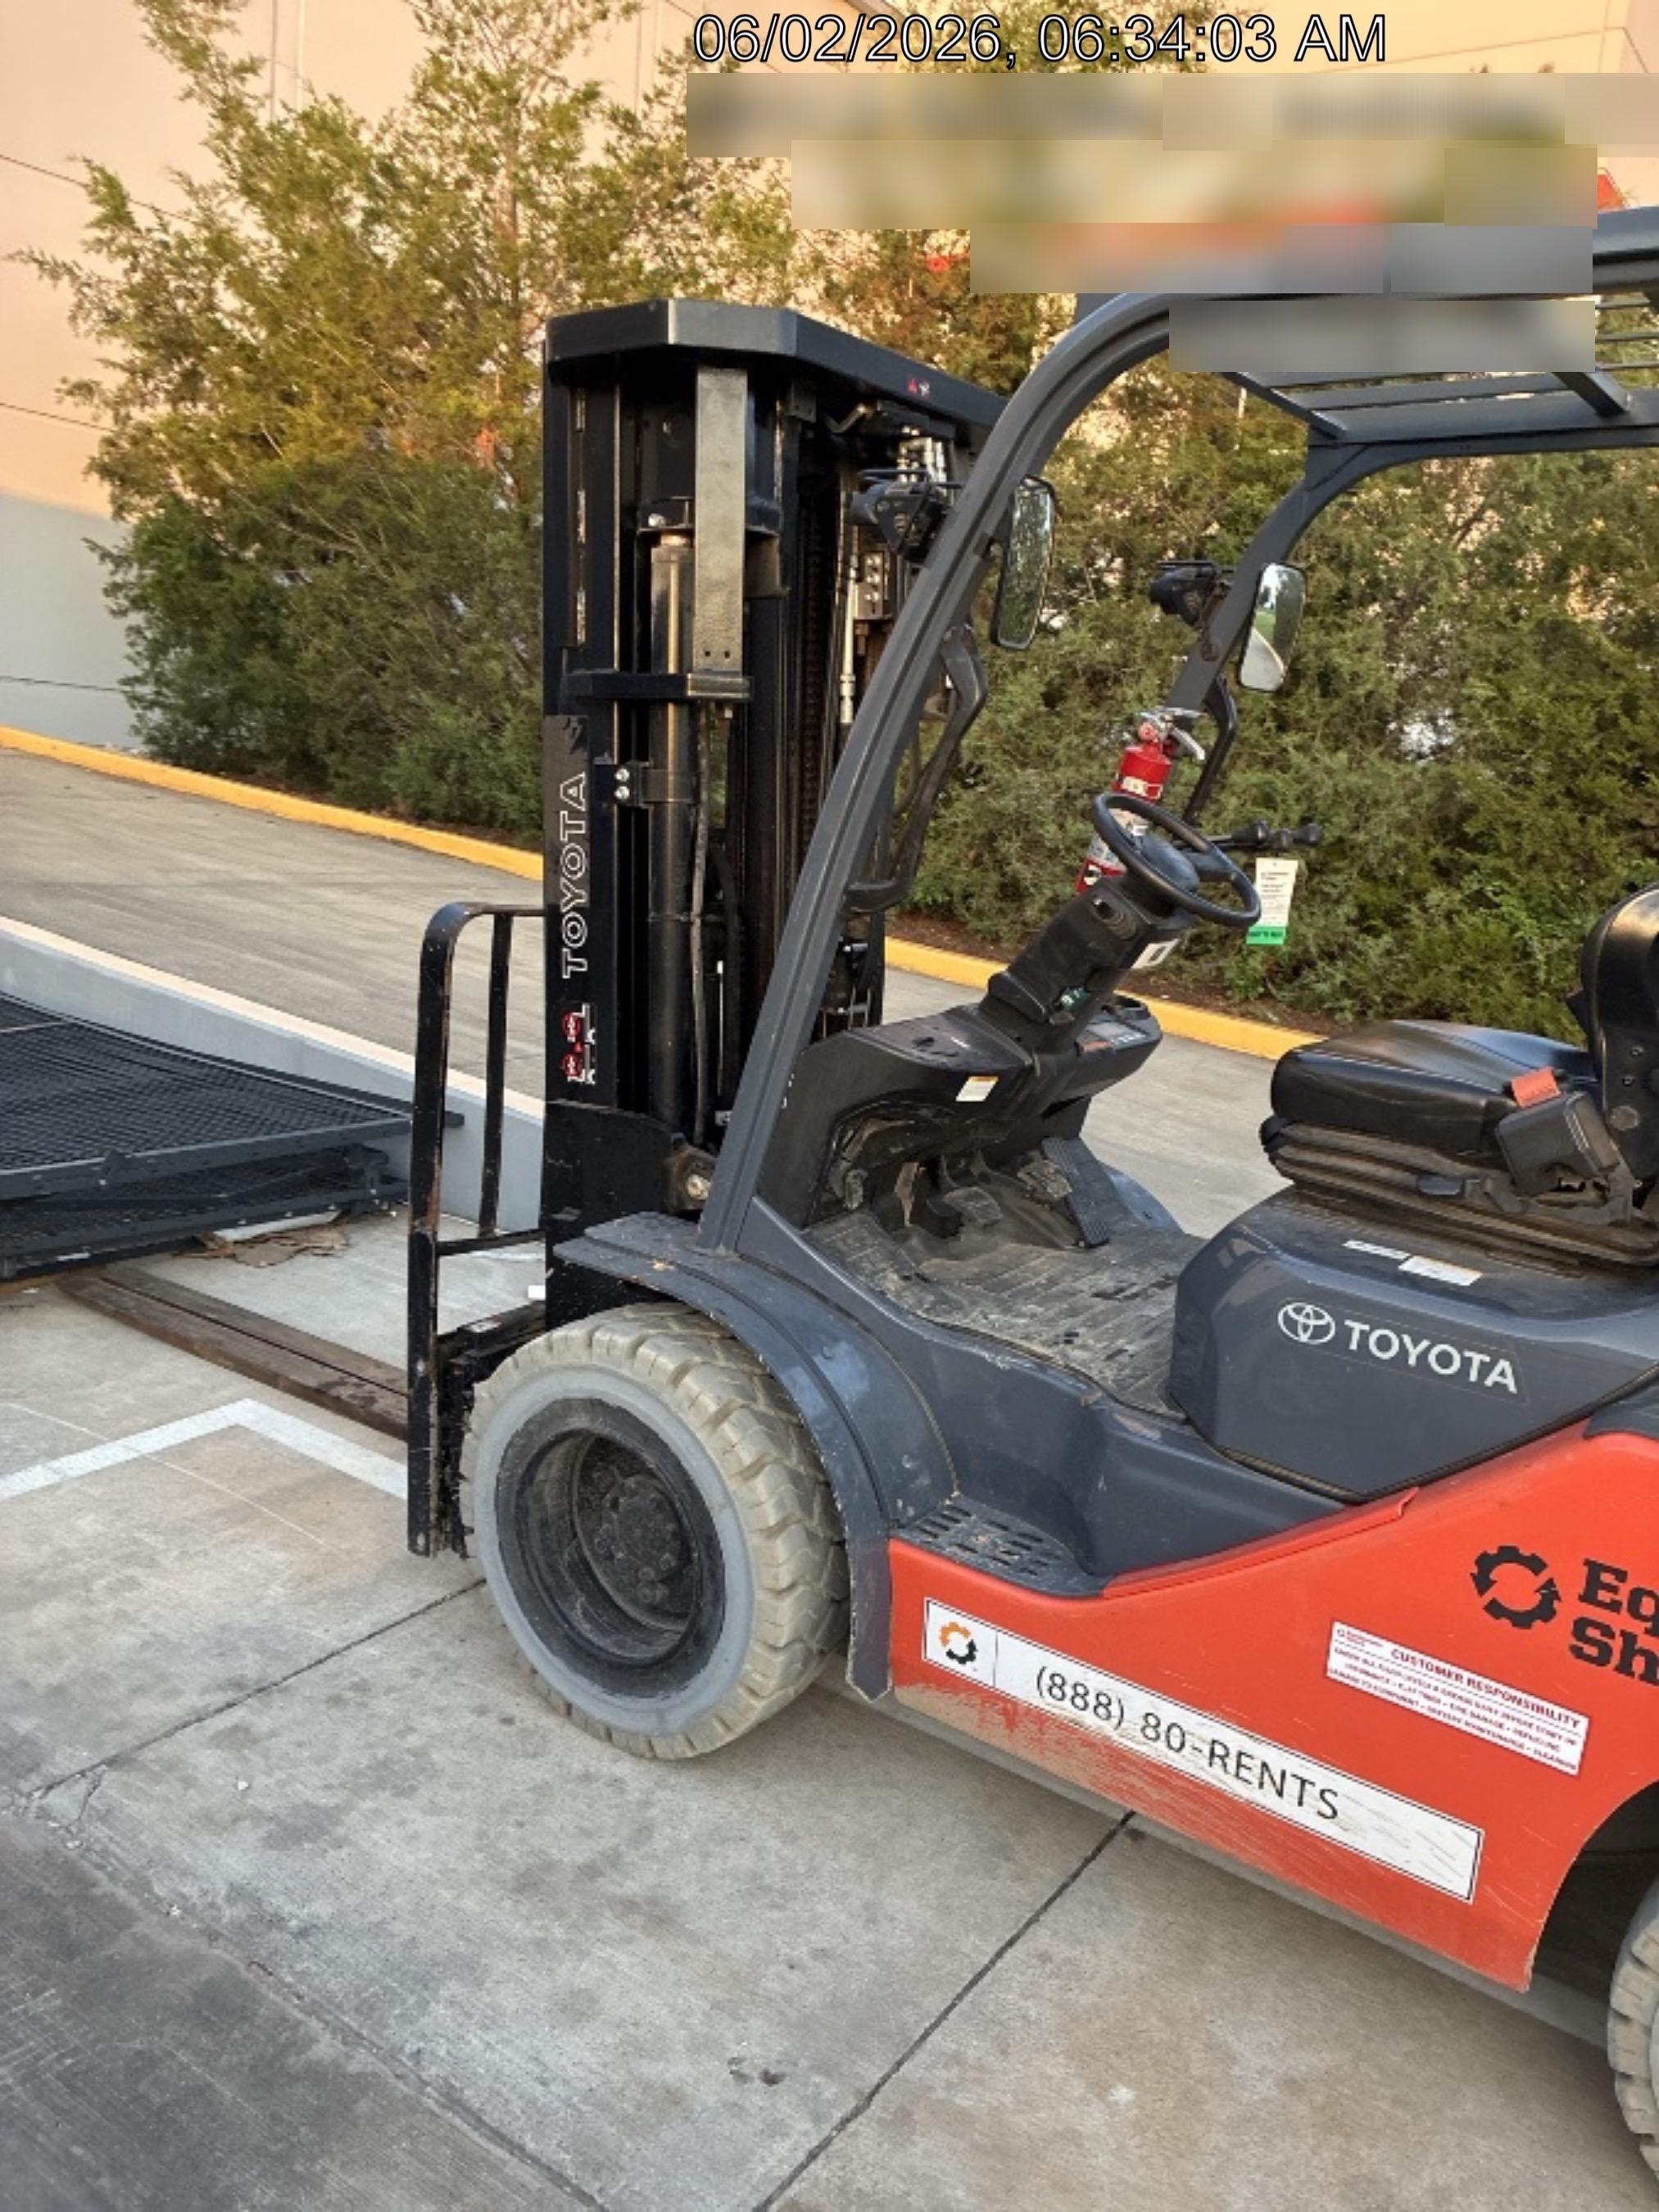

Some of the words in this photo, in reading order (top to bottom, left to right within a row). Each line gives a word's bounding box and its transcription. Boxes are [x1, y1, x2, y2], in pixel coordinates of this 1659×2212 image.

[560, 771, 588, 979] TOYOTA
[1344, 1319, 1518, 1394] TOYOTA
[1036, 1666, 1125, 1730] (888)
[1140, 1711, 1339, 1820] 80-RENTS
[1390, 1648, 1464, 1684] CUSTOMER
[1466, 1677, 1581, 1729] RESPONSIBILITY
